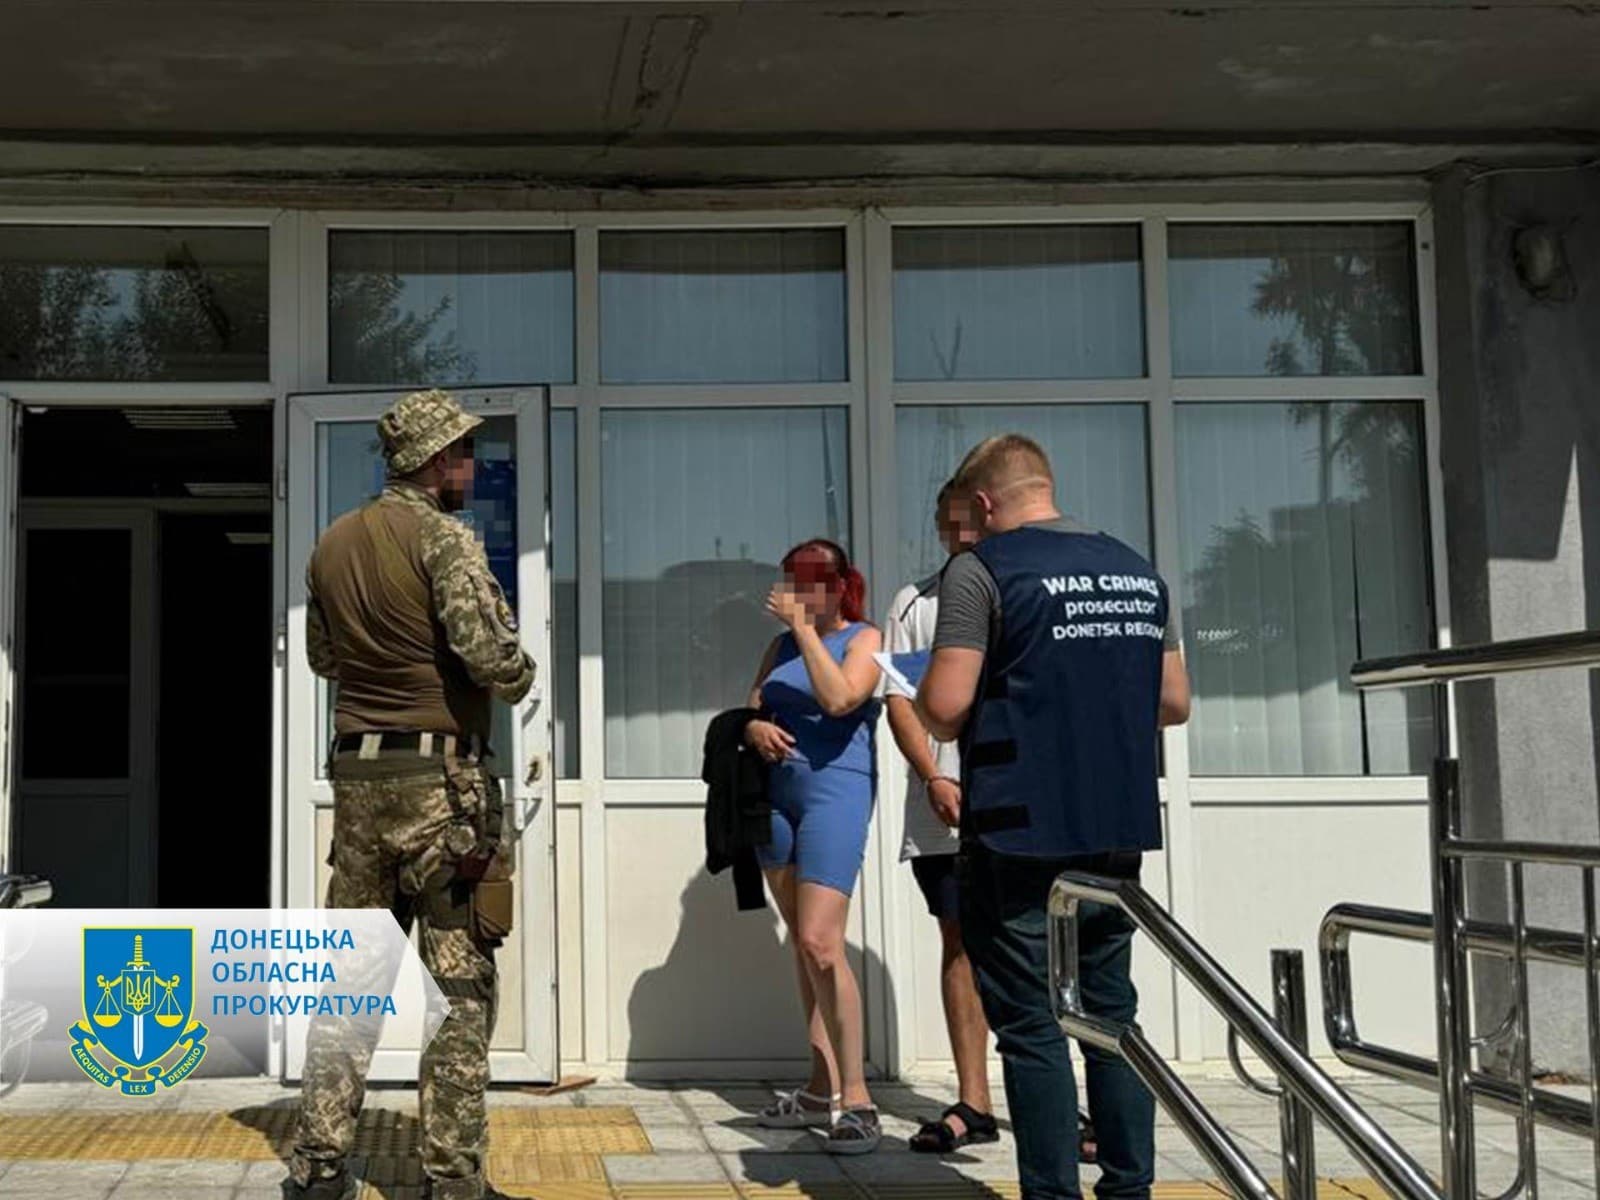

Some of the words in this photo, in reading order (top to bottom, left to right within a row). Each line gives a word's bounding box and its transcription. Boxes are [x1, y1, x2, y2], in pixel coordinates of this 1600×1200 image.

[1042, 575, 1094, 596] WAR
[1098, 575, 1160, 597] CRIMES
[1065, 598, 1157, 620] prosecutor
[1052, 622, 1122, 640] DONETSK
